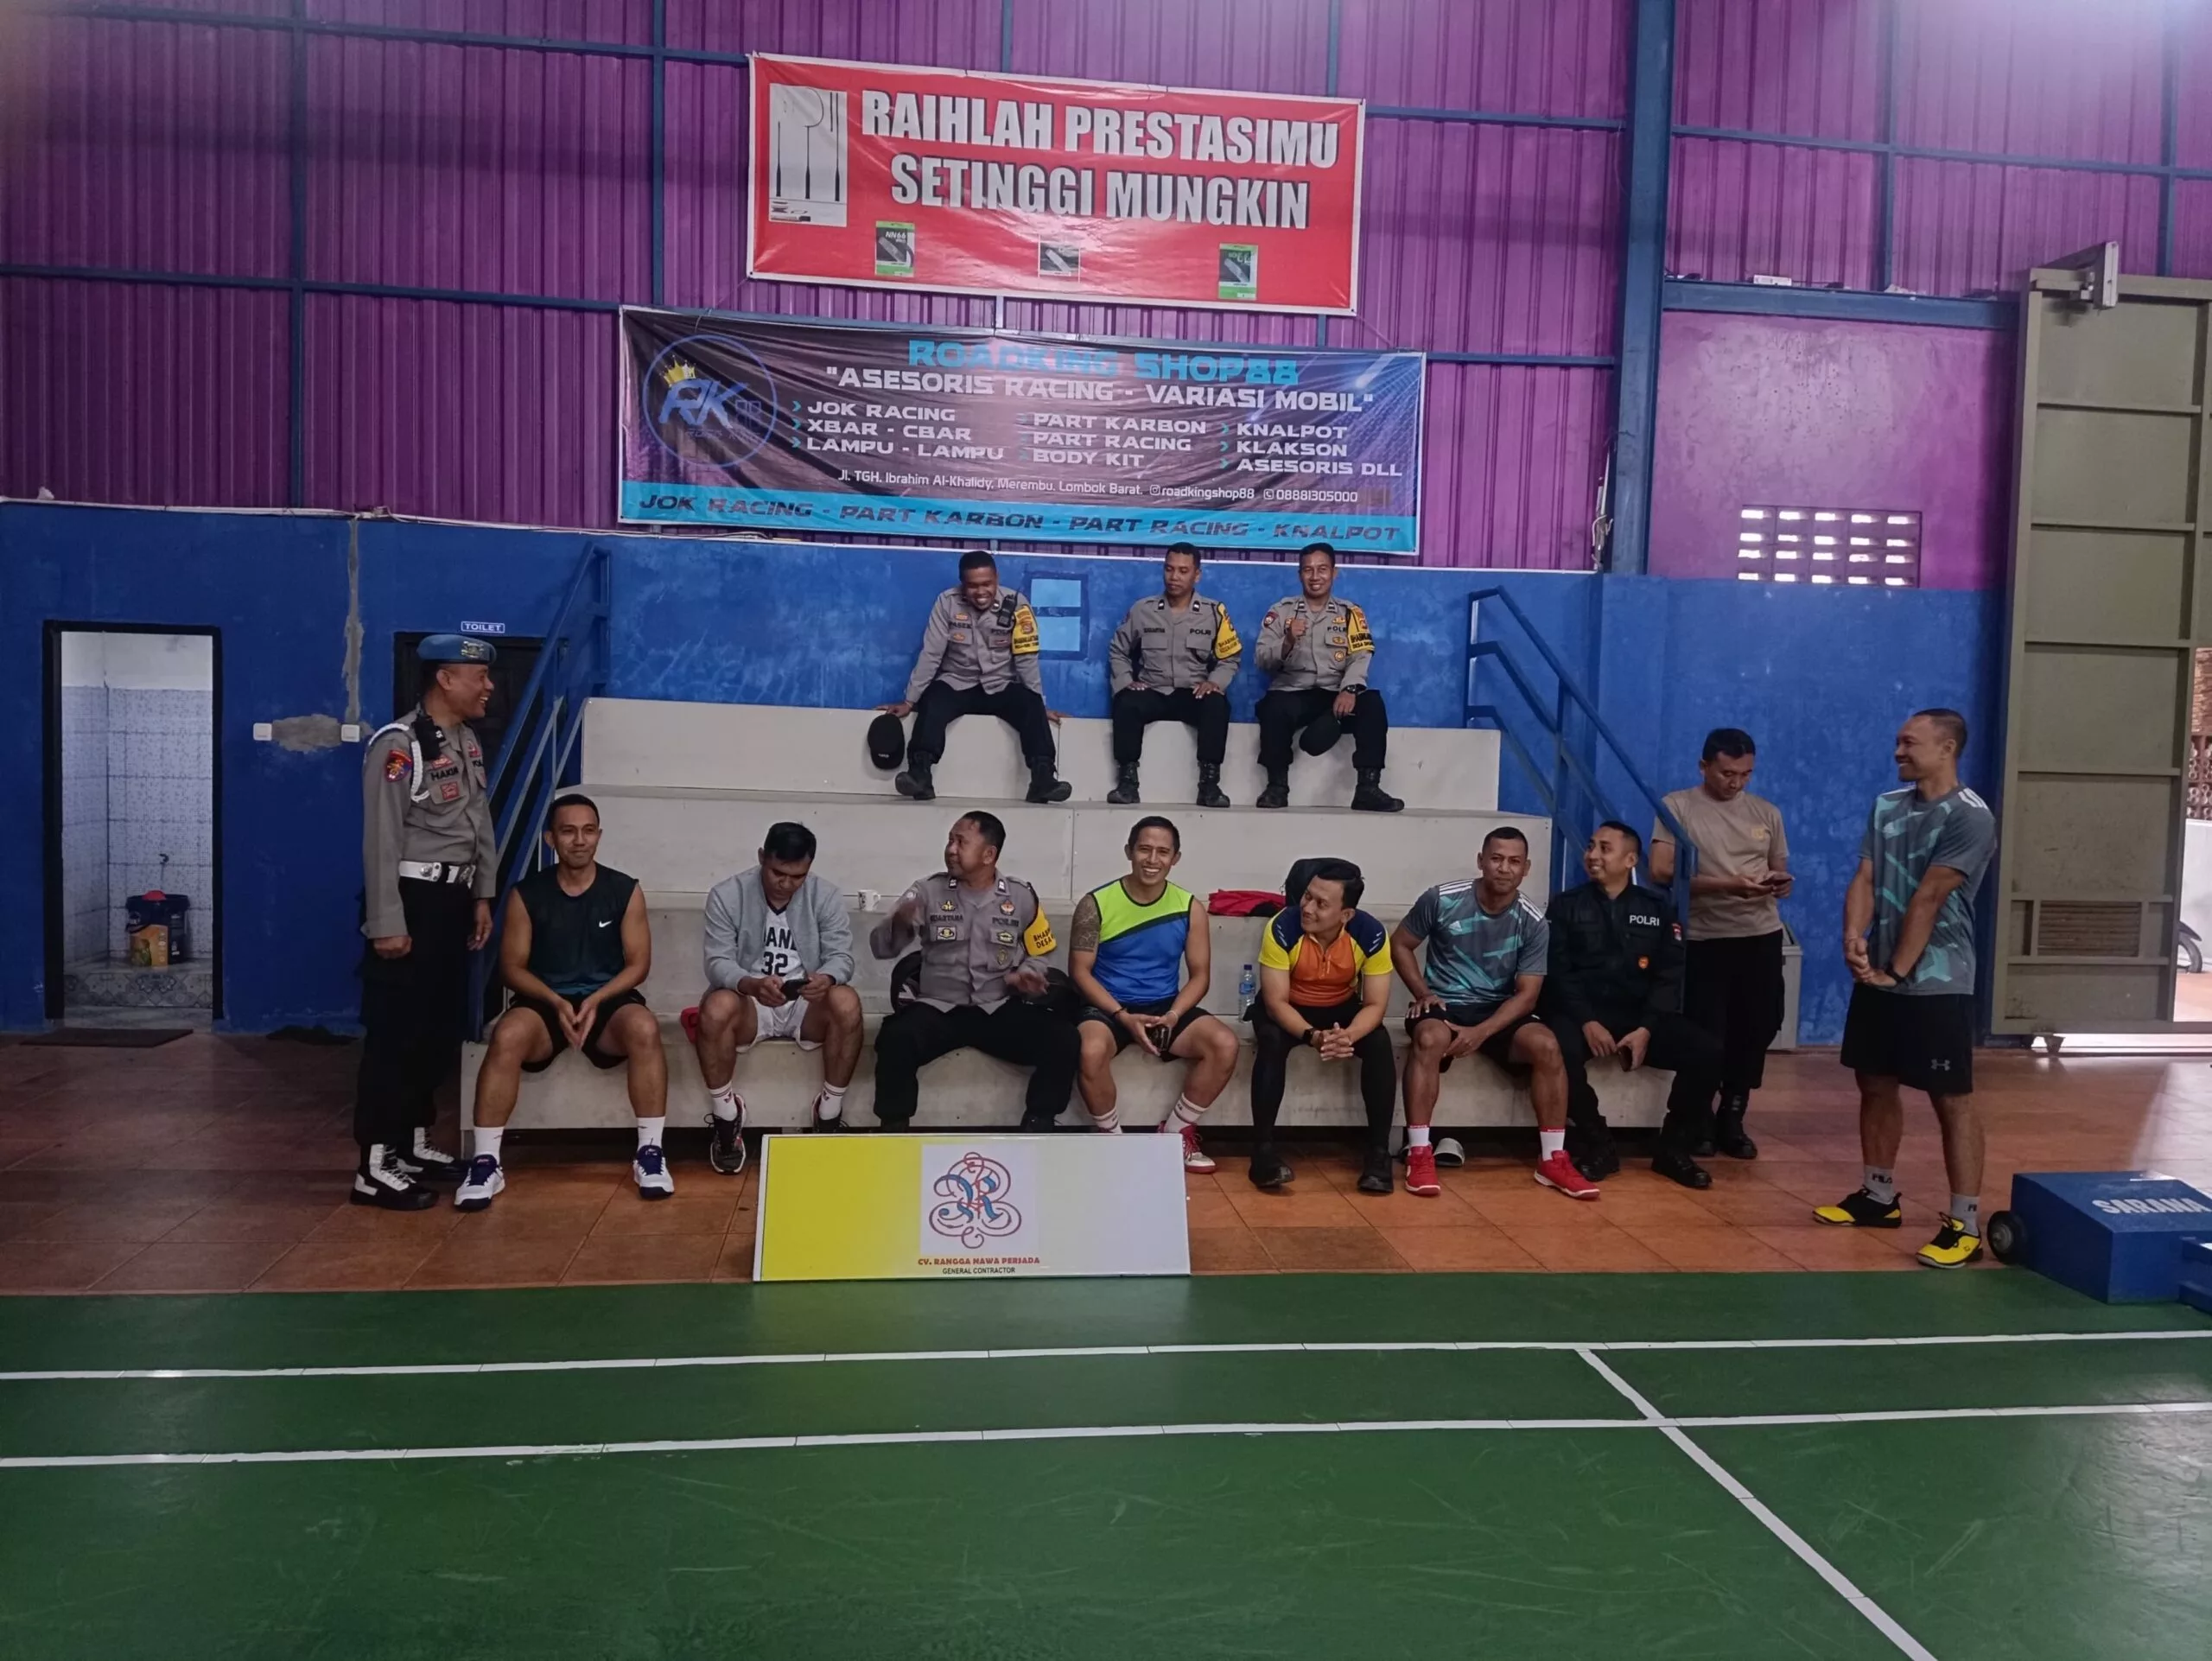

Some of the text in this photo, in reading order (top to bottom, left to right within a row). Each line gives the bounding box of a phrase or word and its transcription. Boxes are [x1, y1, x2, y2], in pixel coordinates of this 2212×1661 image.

[861, 89, 1339, 169] RAIHLAH PRESTASIMU
[891, 153, 1309, 230] SETINGGI MUNGKIN
[908, 339, 1300, 385] ROADKING SHOP88
[826, 366, 995, 395] "ASESORIS
[1004, 377, 1114, 401] RACING
[1145, 385, 1265, 409] VARIASI
[1274, 391, 1373, 412] MOBIL"
[807, 401, 956, 422] JOK RACING
[807, 418, 878, 436] XBAR
[903, 424, 972, 441] CBAR
[1033, 412, 1206, 434] PART KARBON
[1236, 423, 1348, 439] KNALPOT
[806, 436, 894, 455] LAMPU
[918, 443, 1004, 461] LAMPU
[1033, 431, 1192, 451] PART RACING
[1236, 441, 1348, 457] KLAKSON
[1033, 448, 1145, 467] BODY KIT
[1236, 458, 1403, 477] ASESORIS DLL
[854, 470, 882, 483] TGH.
[886, 471, 930, 486] Ibrahim
[1058, 480, 1106, 494] Lombok
[1161, 486, 1255, 502] roadkingshop88
[1275, 488, 1358, 502] 08881305000
[639, 494, 698, 512] JOK
[708, 497, 814, 518] RACING
[839, 506, 917, 523] PART
[923, 509, 1045, 529] KARBON
[1068, 516, 1144, 532] PART
[1149, 519, 1250, 537] RACING
[1273, 523, 1401, 541] KNALPOT
[464, 623, 502, 632] TOILET
[1629, 914, 1660, 926] POLRI
[761, 951, 788, 977] 32
[2091, 1198, 2212, 1214] SARANA
[972, 1266, 1016, 1275] CONTRACTOR
